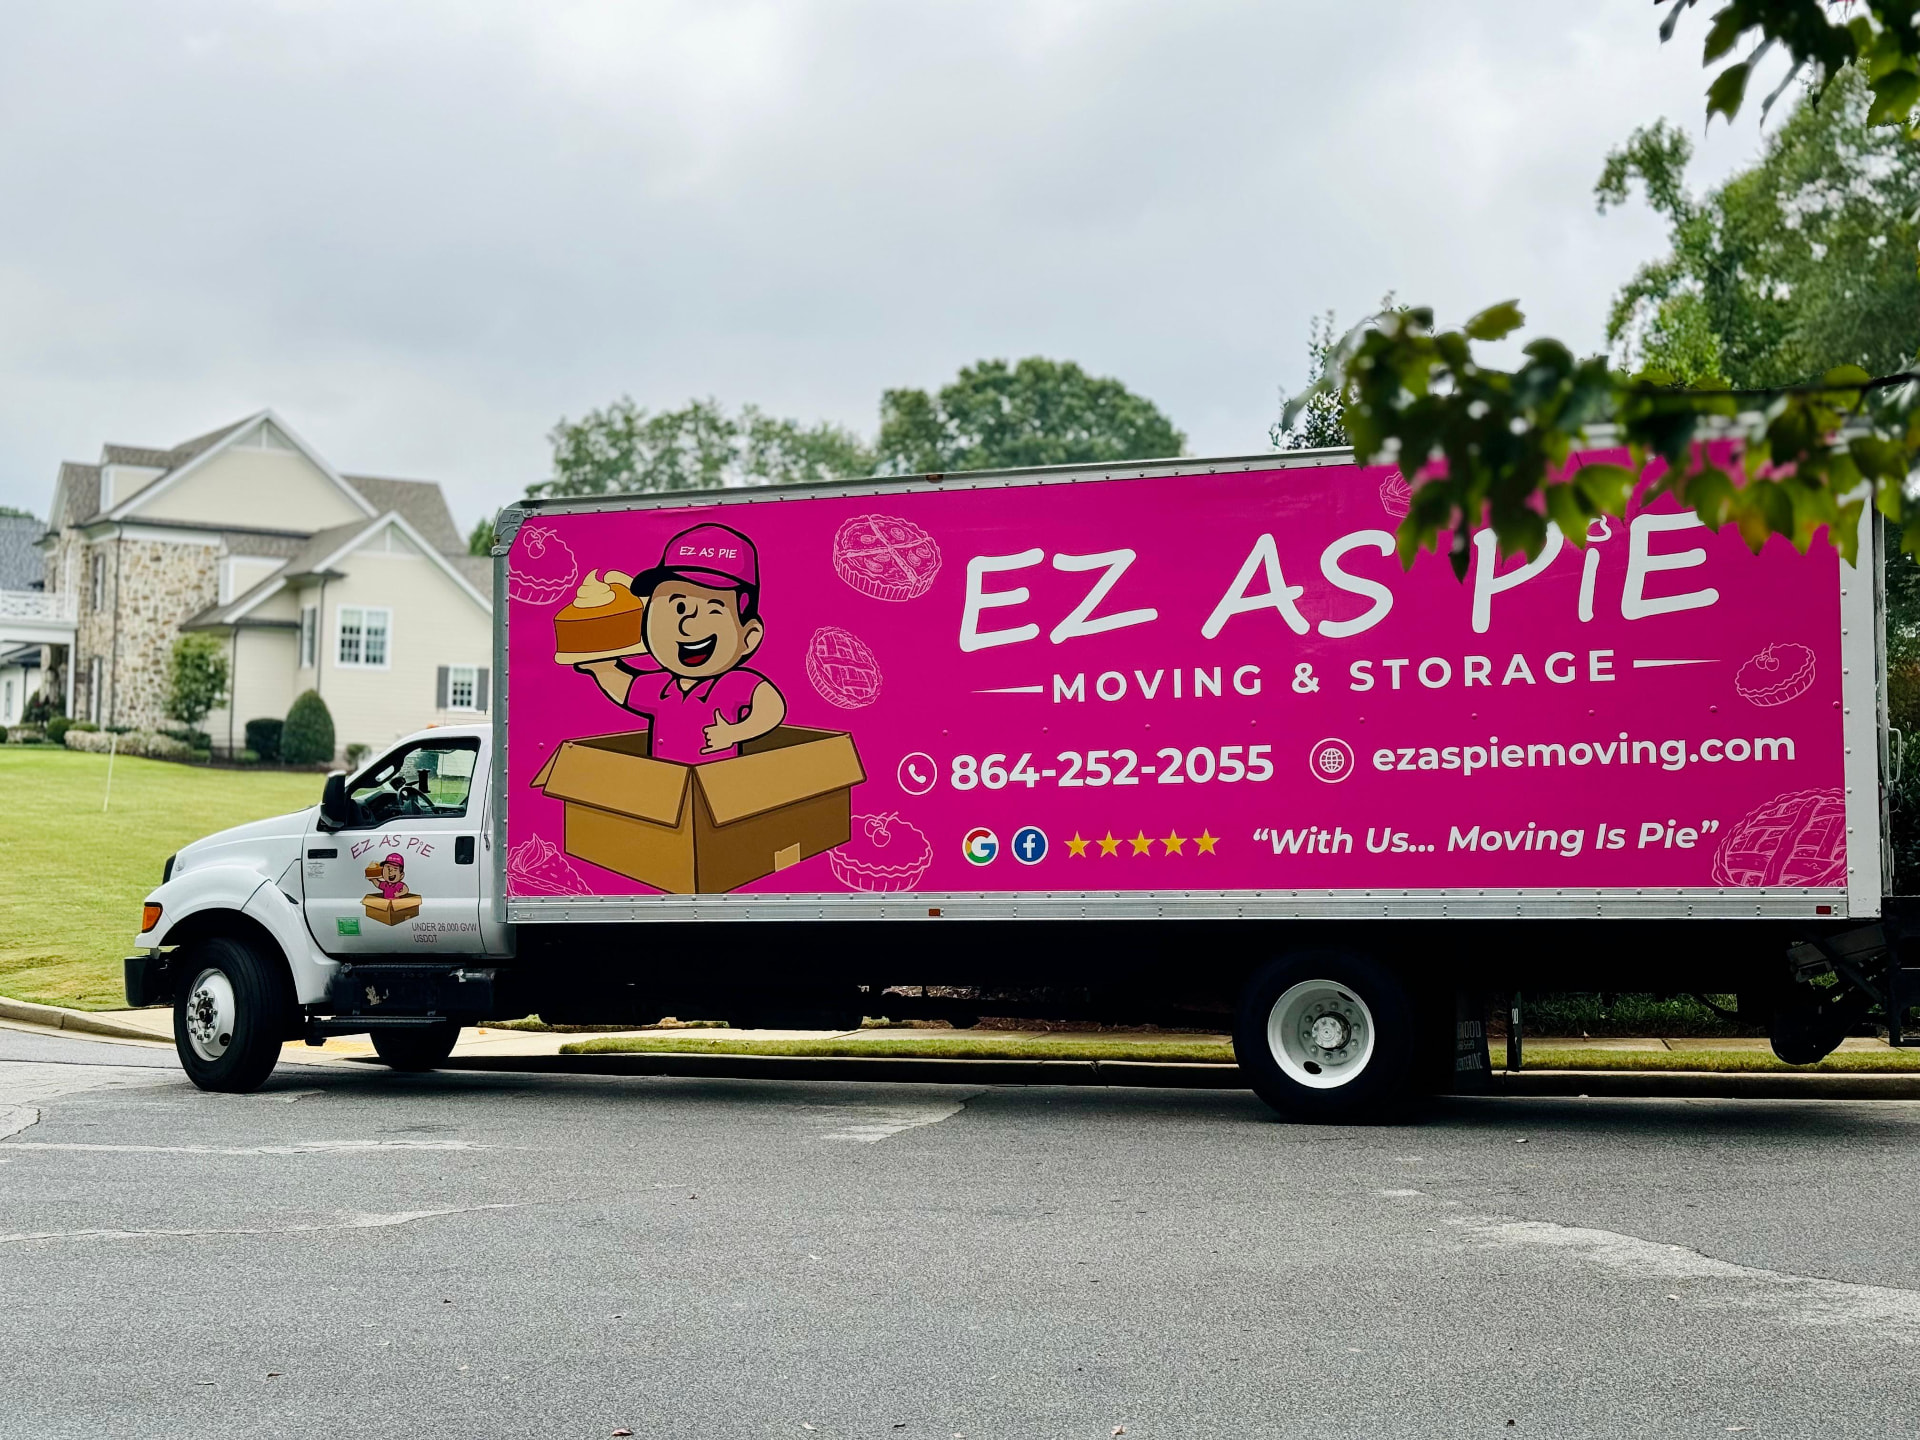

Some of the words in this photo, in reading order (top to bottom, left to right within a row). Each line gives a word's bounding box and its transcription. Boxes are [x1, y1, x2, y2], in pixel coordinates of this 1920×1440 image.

[679, 546, 697, 556] EZ
[699, 547, 715, 558] AS
[960, 548, 1159, 653] EZ
[1201, 530, 1397, 640] AS
[1053, 664, 1262, 704] MOVING
[1291, 663, 1320, 694] &
[1349, 649, 1616, 692] STORAGE
[950, 744, 1274, 791] 864-252-2055
[1372, 731, 1795, 776] ezaspiemoving.com
[350, 838, 376, 860] EZ
[379, 833, 402, 849] AS
[1252, 825, 1353, 855] “With
[1366, 827, 1435, 854] Us...
[1447, 821, 1585, 857] Moving
[1595, 823, 1626, 850] Is
[1637, 819, 1720, 849] Pie”
[411, 922, 437, 932] UNDER
[460, 922, 477, 932] GVW
[413, 934, 438, 944] USDOT
